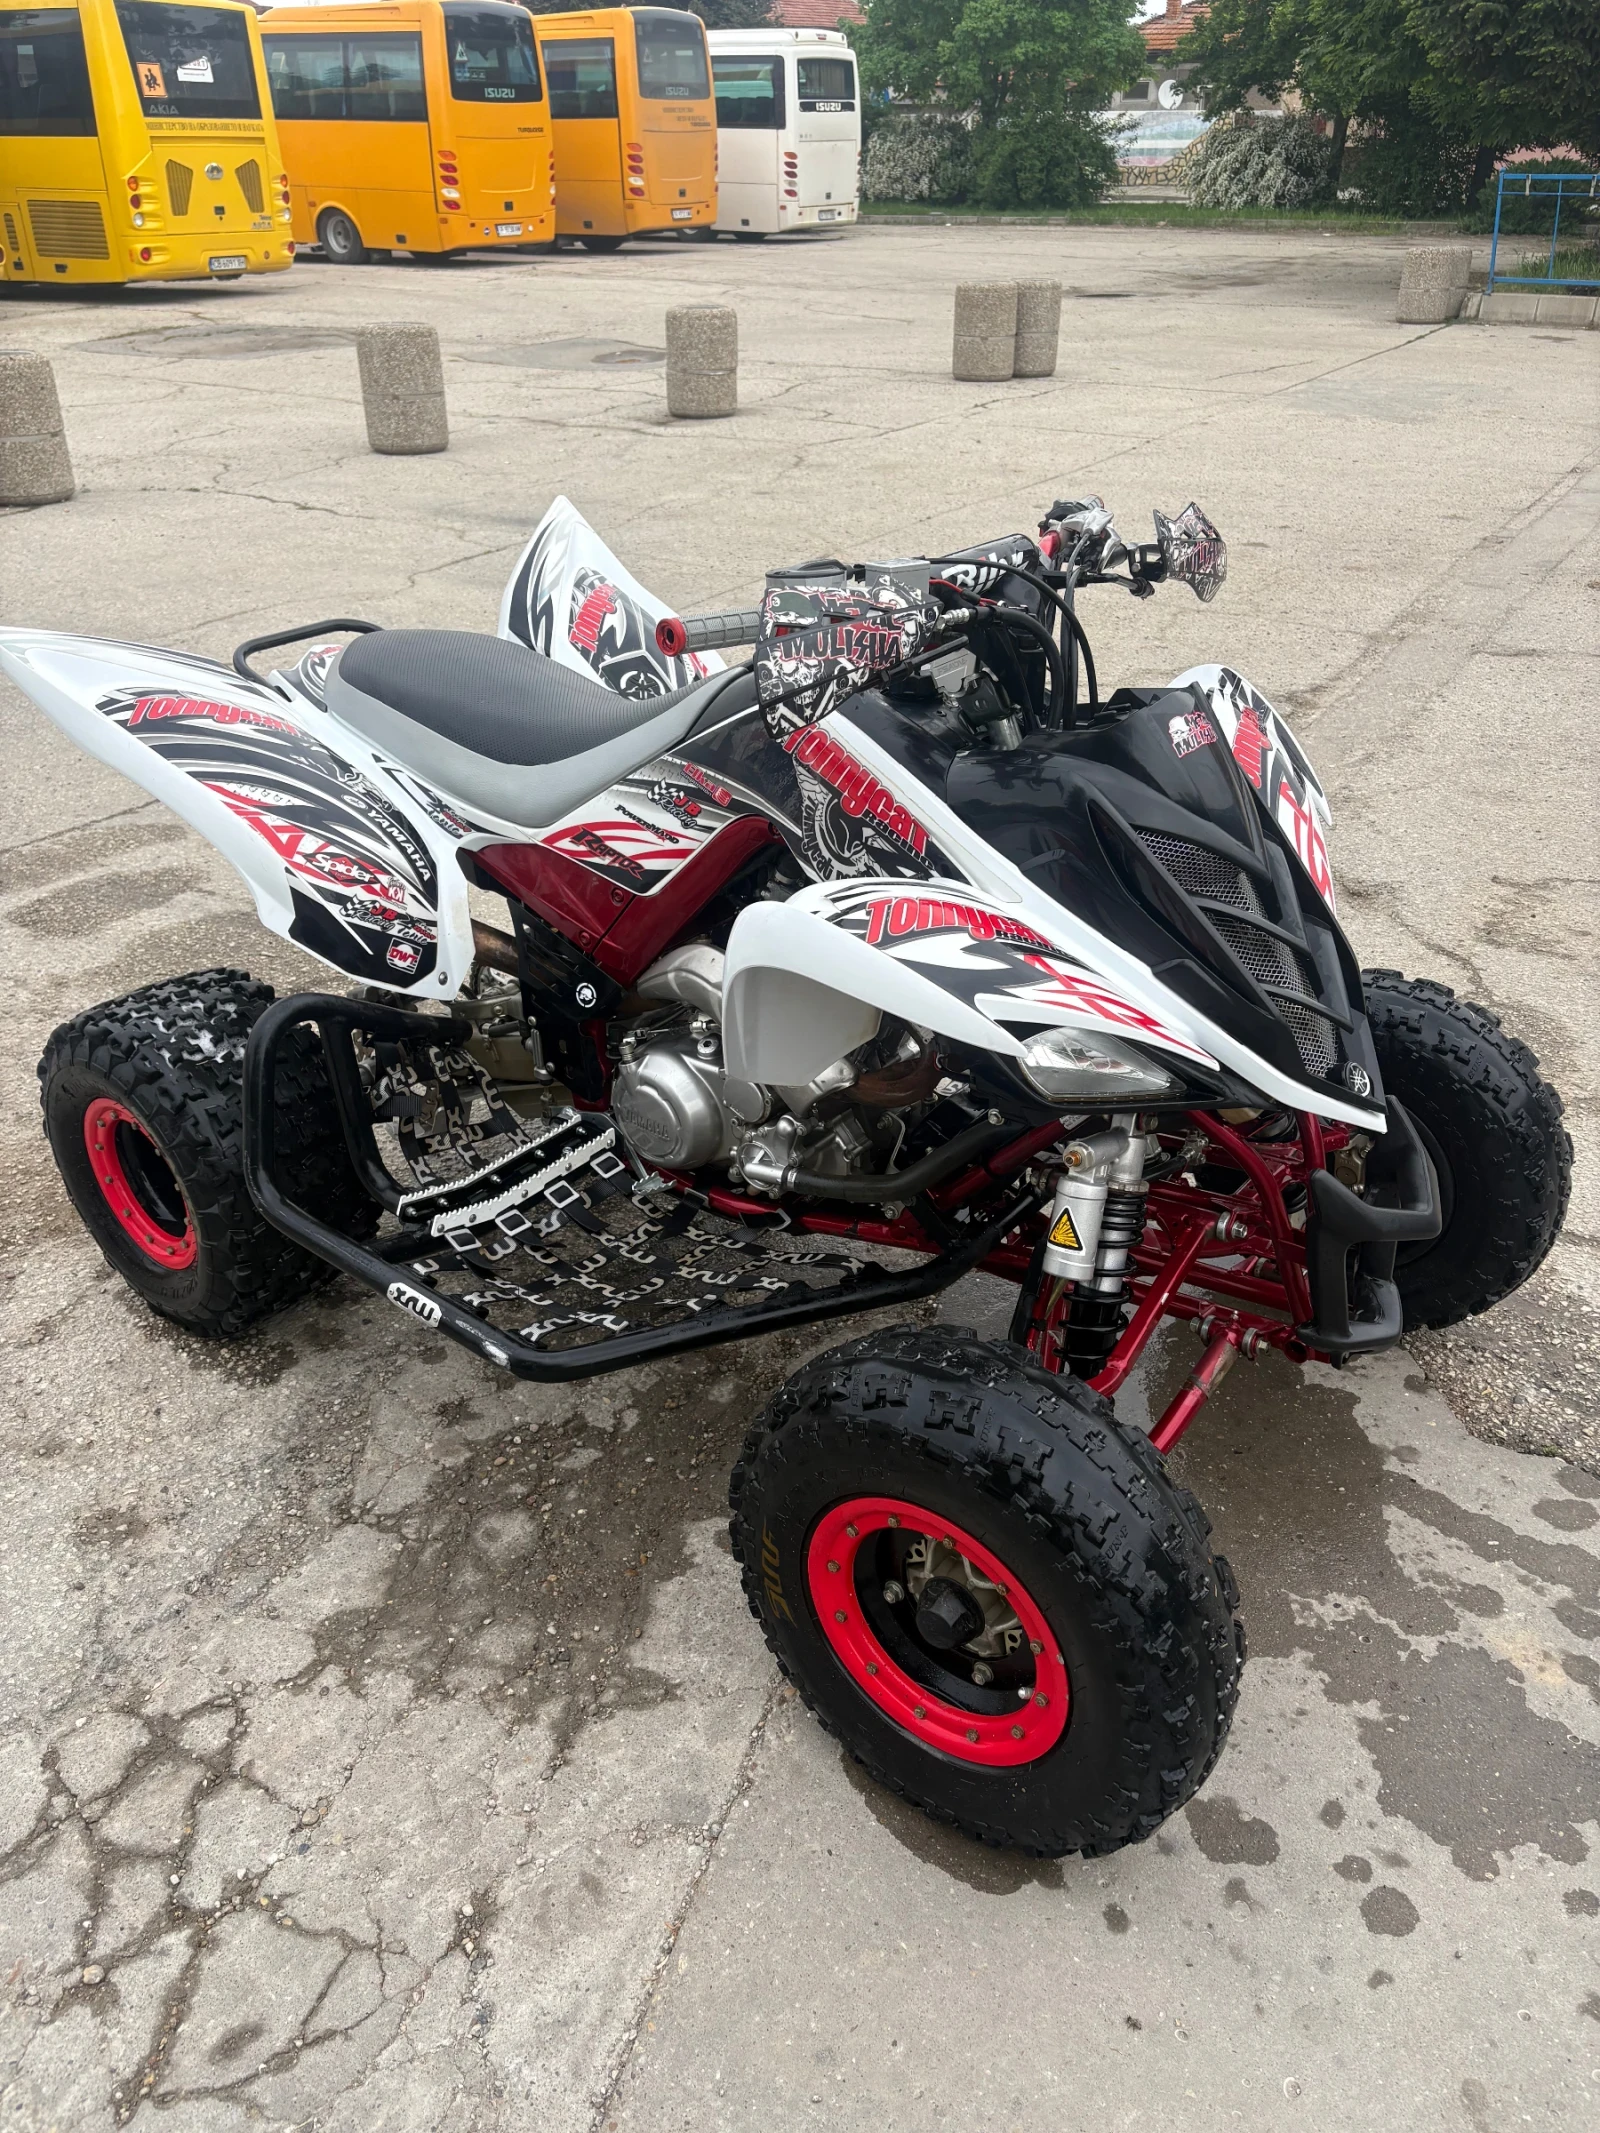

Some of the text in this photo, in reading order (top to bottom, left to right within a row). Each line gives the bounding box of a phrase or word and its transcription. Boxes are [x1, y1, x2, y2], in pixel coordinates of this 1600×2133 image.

[484, 88, 515, 98] ISUZU
[665, 86, 689, 96] ISUZU
[149, 104, 179, 115] AKIA
[815, 102, 842, 111] ISUZU
[658, 796, 699, 830] Racing
[367, 810, 432, 882] YAMAHA
[312, 853, 375, 884] Spider
[389, 946, 419, 965] DWT
